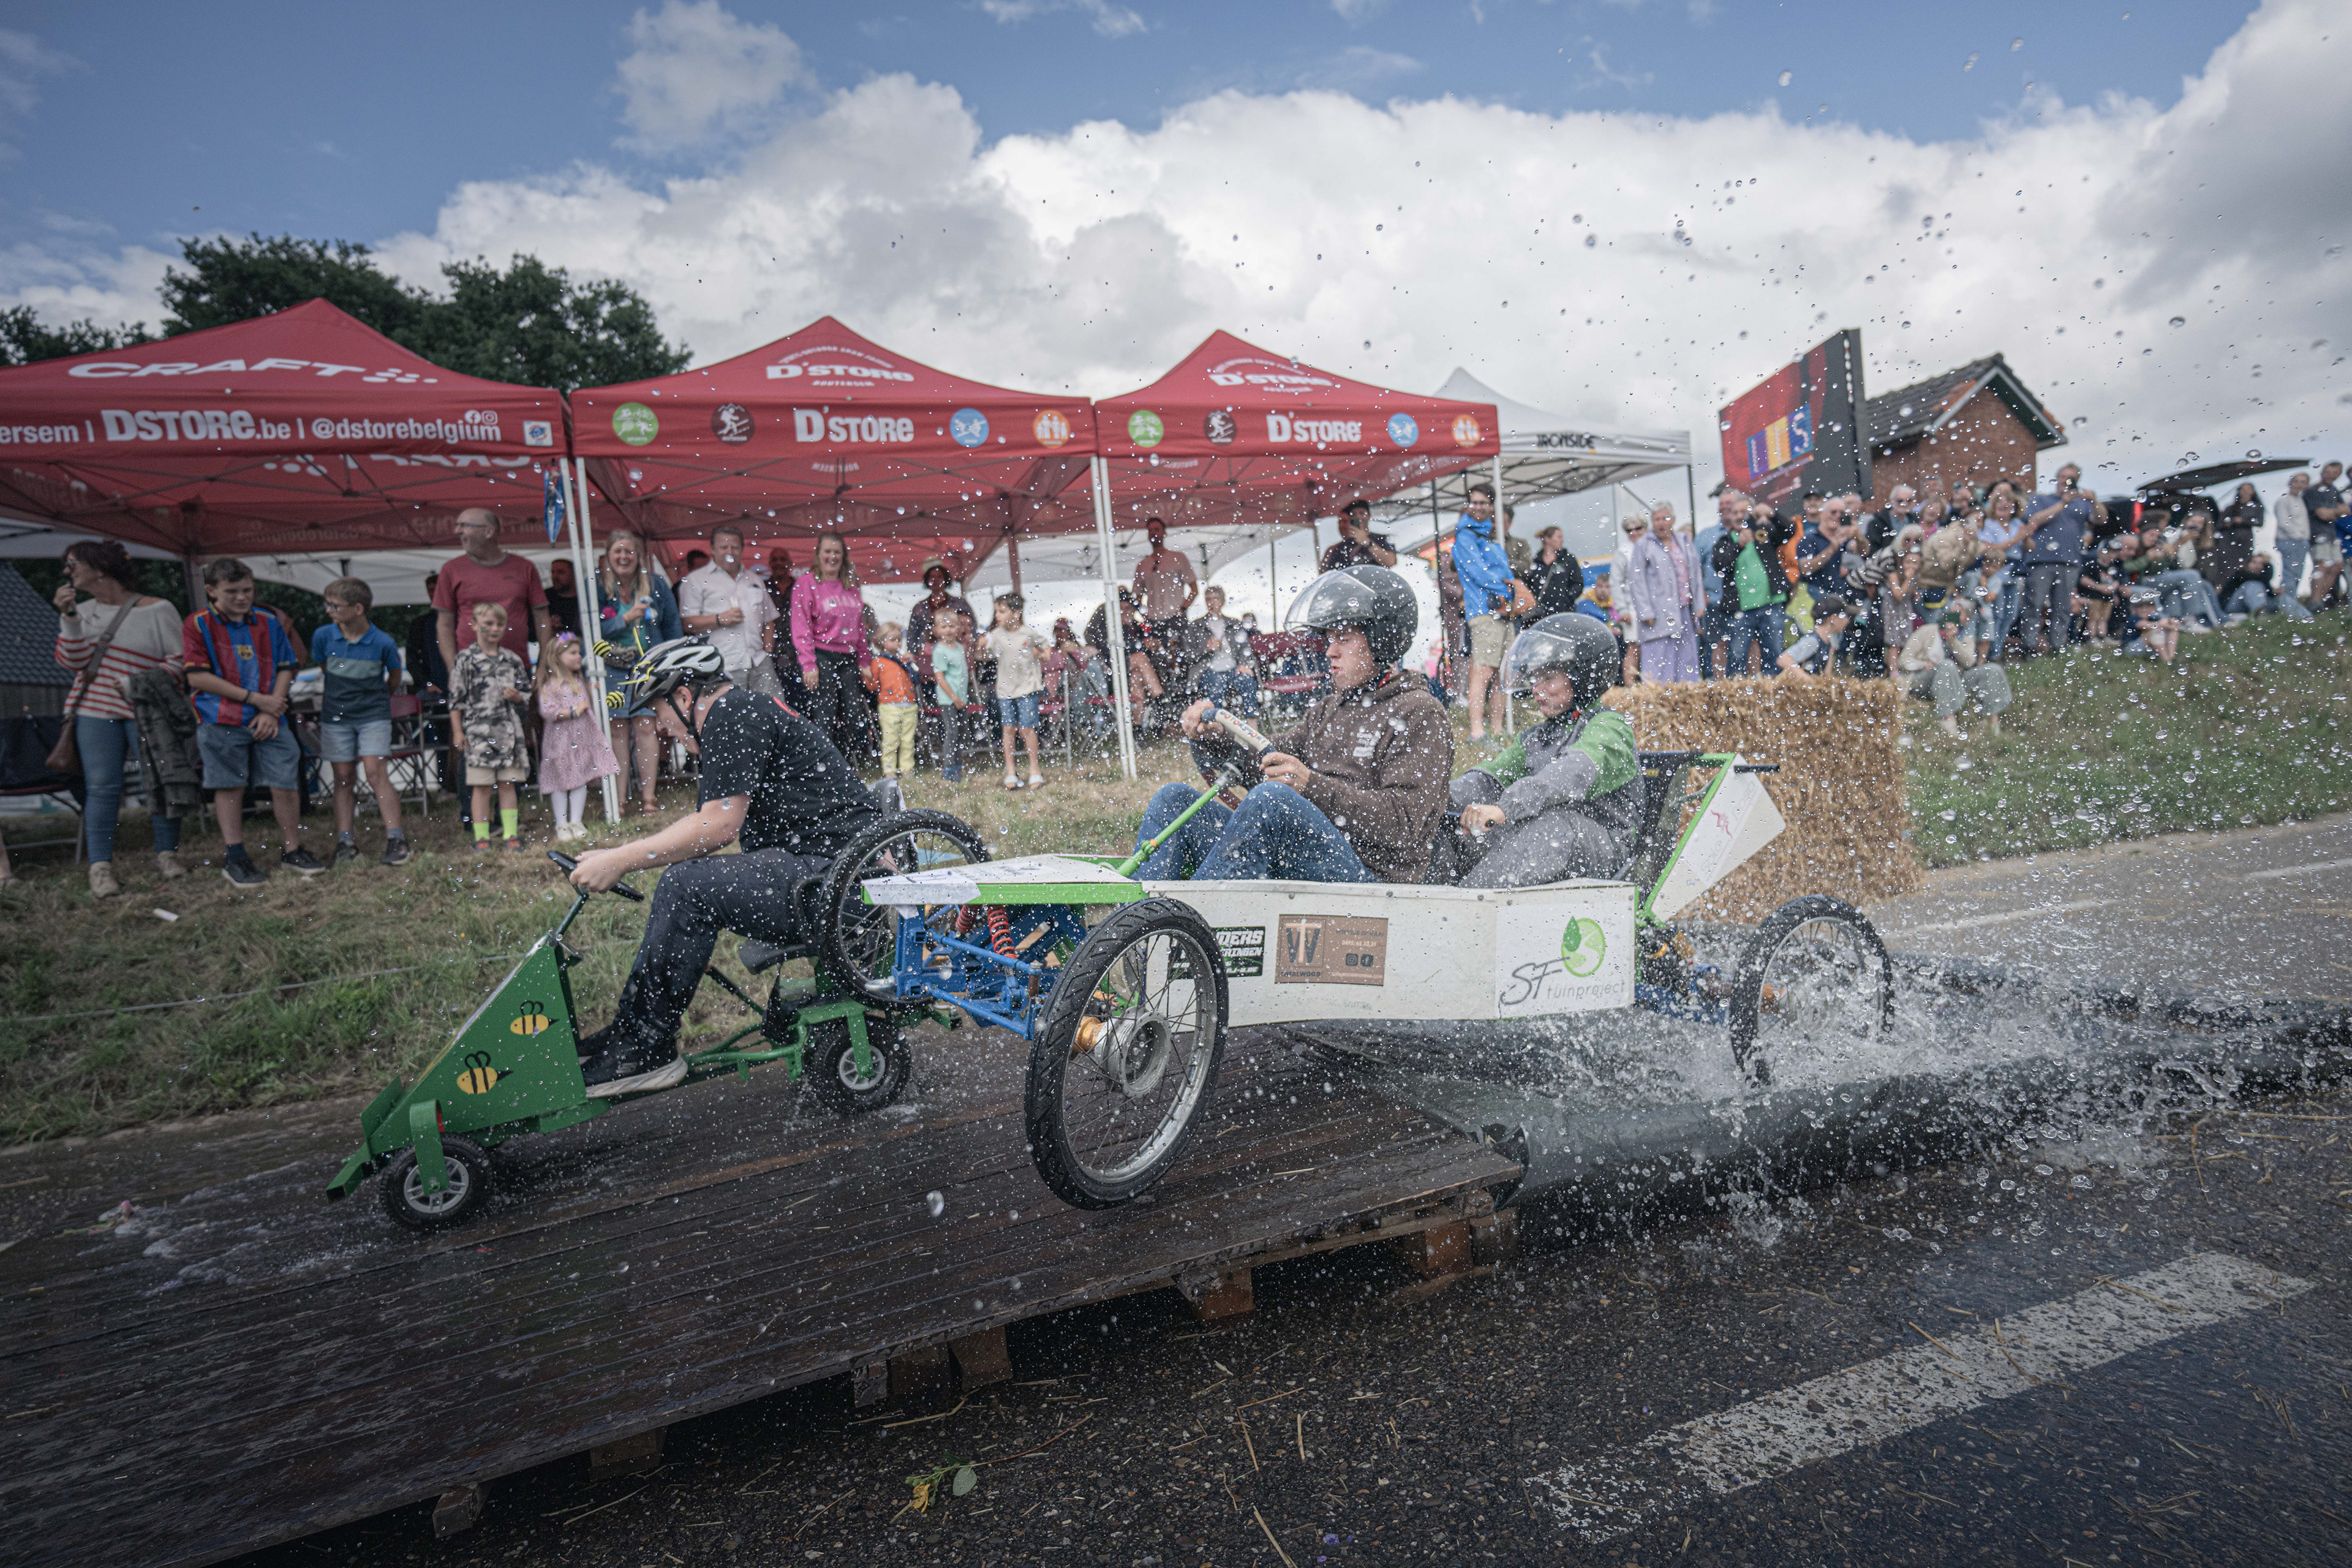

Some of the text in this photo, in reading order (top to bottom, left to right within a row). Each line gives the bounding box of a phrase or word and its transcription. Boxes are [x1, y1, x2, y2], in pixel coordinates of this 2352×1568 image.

[68, 358, 366, 378] CRAFT
[312, 417, 502, 444] @dstorebelgium
[1547, 981, 1626, 1001] tuinproject
